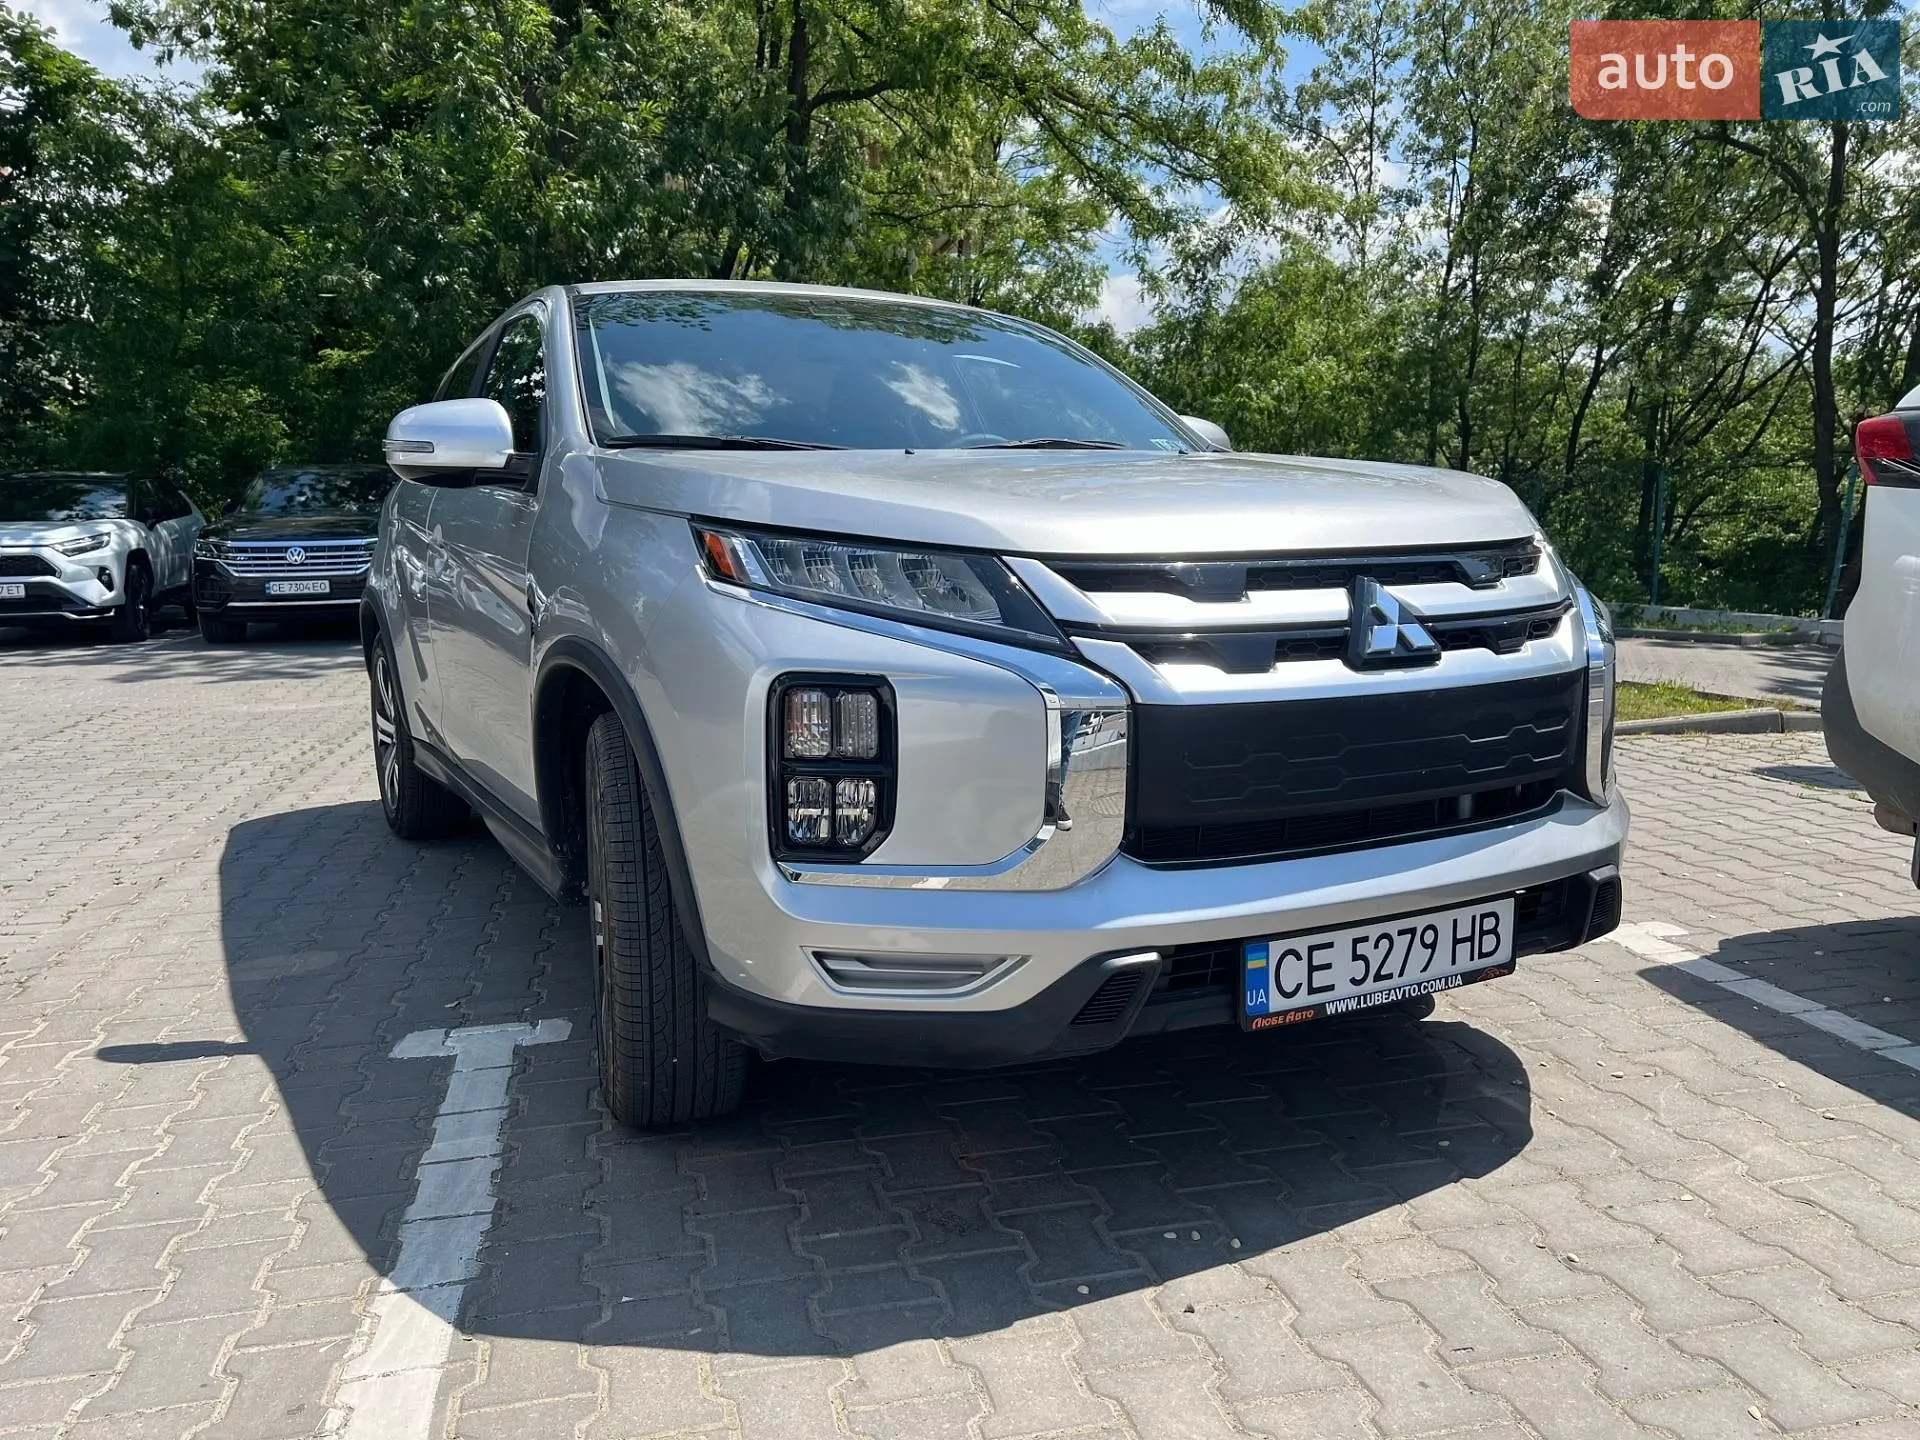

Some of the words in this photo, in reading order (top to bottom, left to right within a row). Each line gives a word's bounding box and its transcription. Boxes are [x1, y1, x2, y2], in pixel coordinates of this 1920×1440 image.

[271, 583, 286, 593] CE
[288, 582, 311, 593] 7304
[1274, 941, 1335, 999] CE
[1349, 923, 1439, 987] 5279
[1451, 911, 1502, 966] HB
[1247, 988, 1267, 1006] UA
[1325, 974, 1463, 1015] WWW.LUBEAVTO.COM.UA
